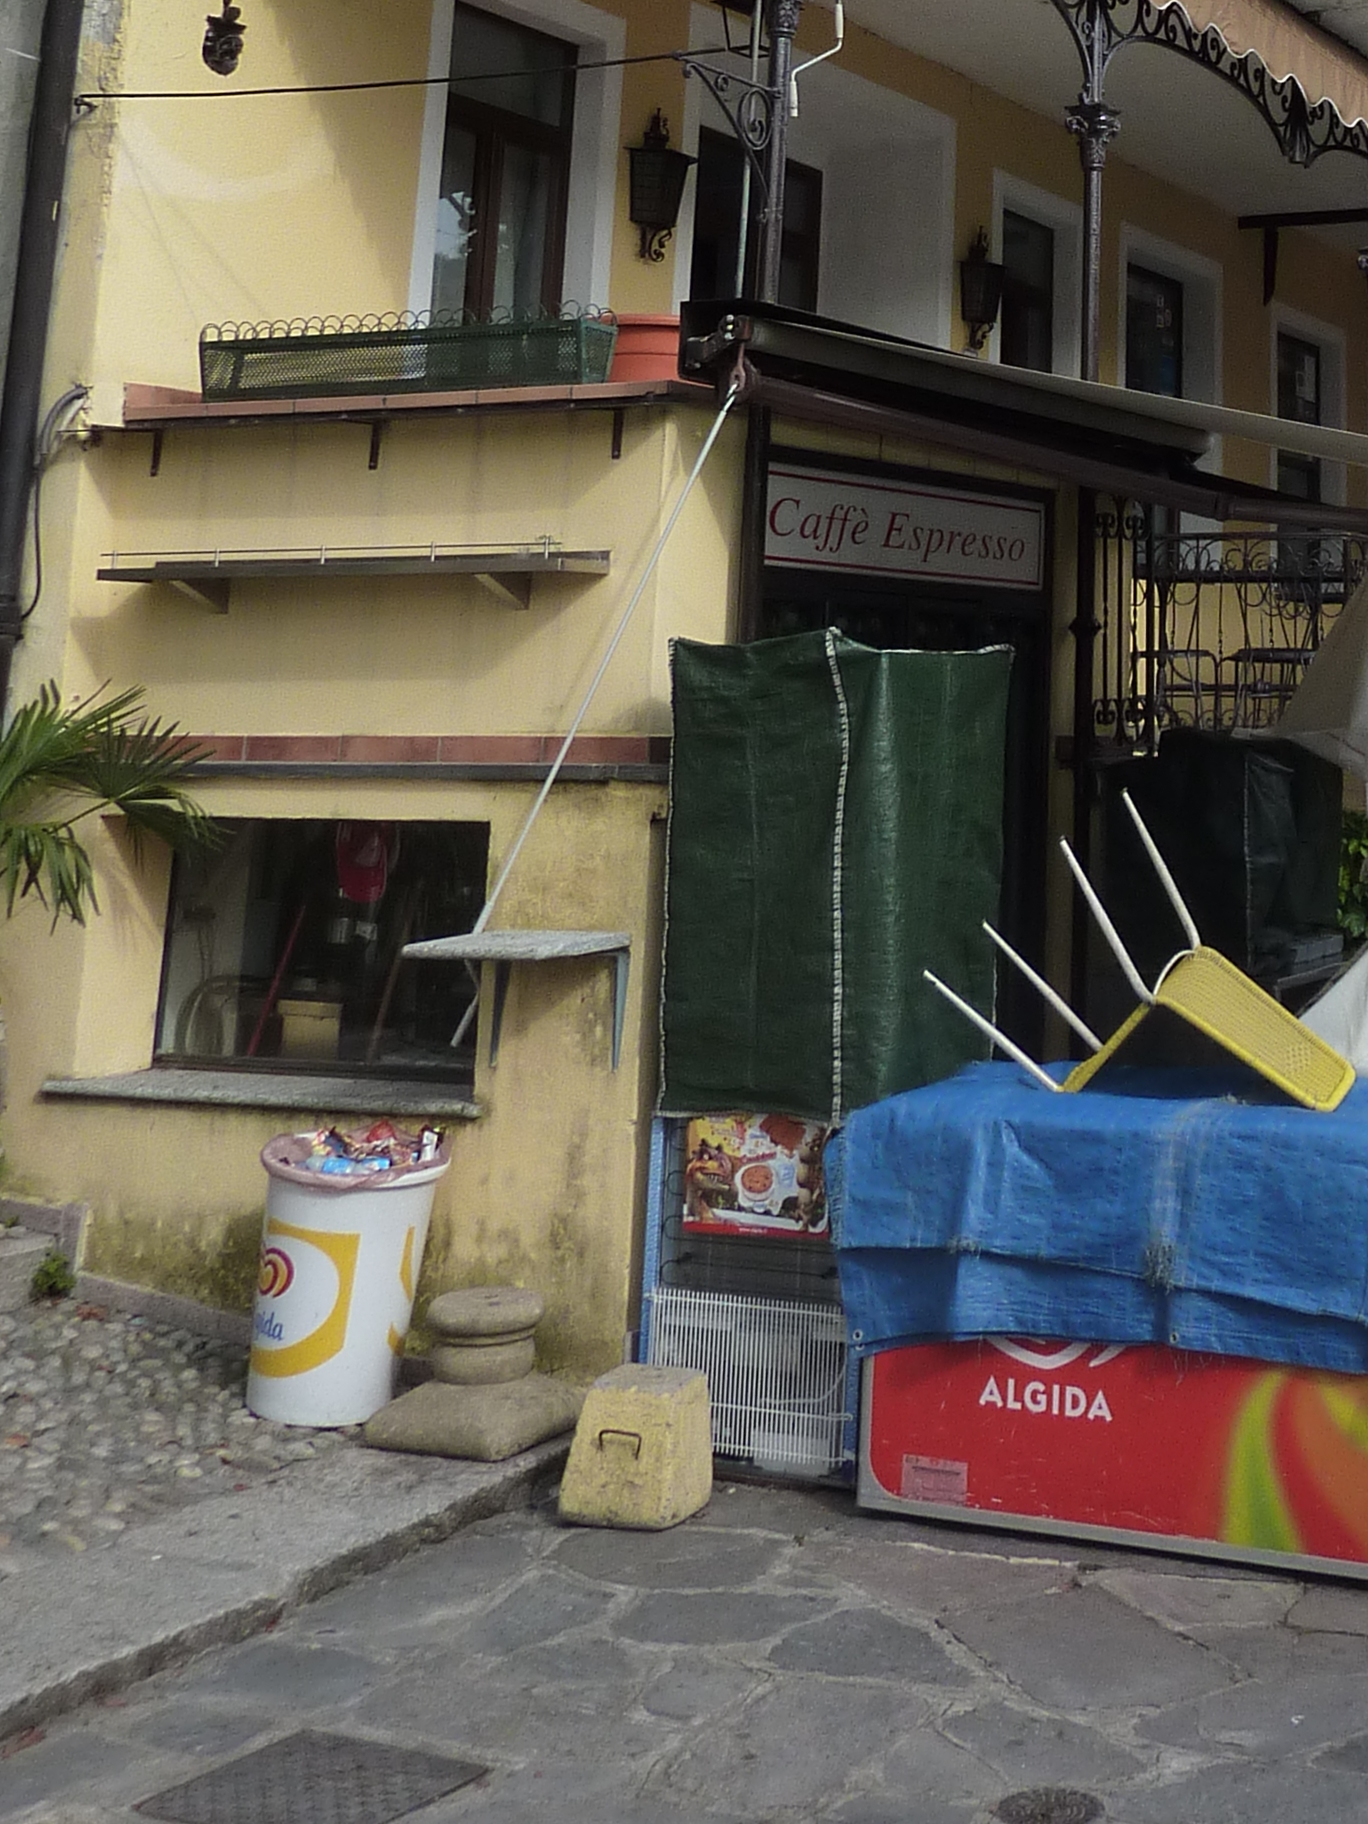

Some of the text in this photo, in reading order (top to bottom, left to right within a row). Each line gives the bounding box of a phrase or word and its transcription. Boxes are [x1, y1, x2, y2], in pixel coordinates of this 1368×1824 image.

[768, 497, 1026, 563] Caffè Espresso
[979, 1375, 1113, 1422] ALGIDA
